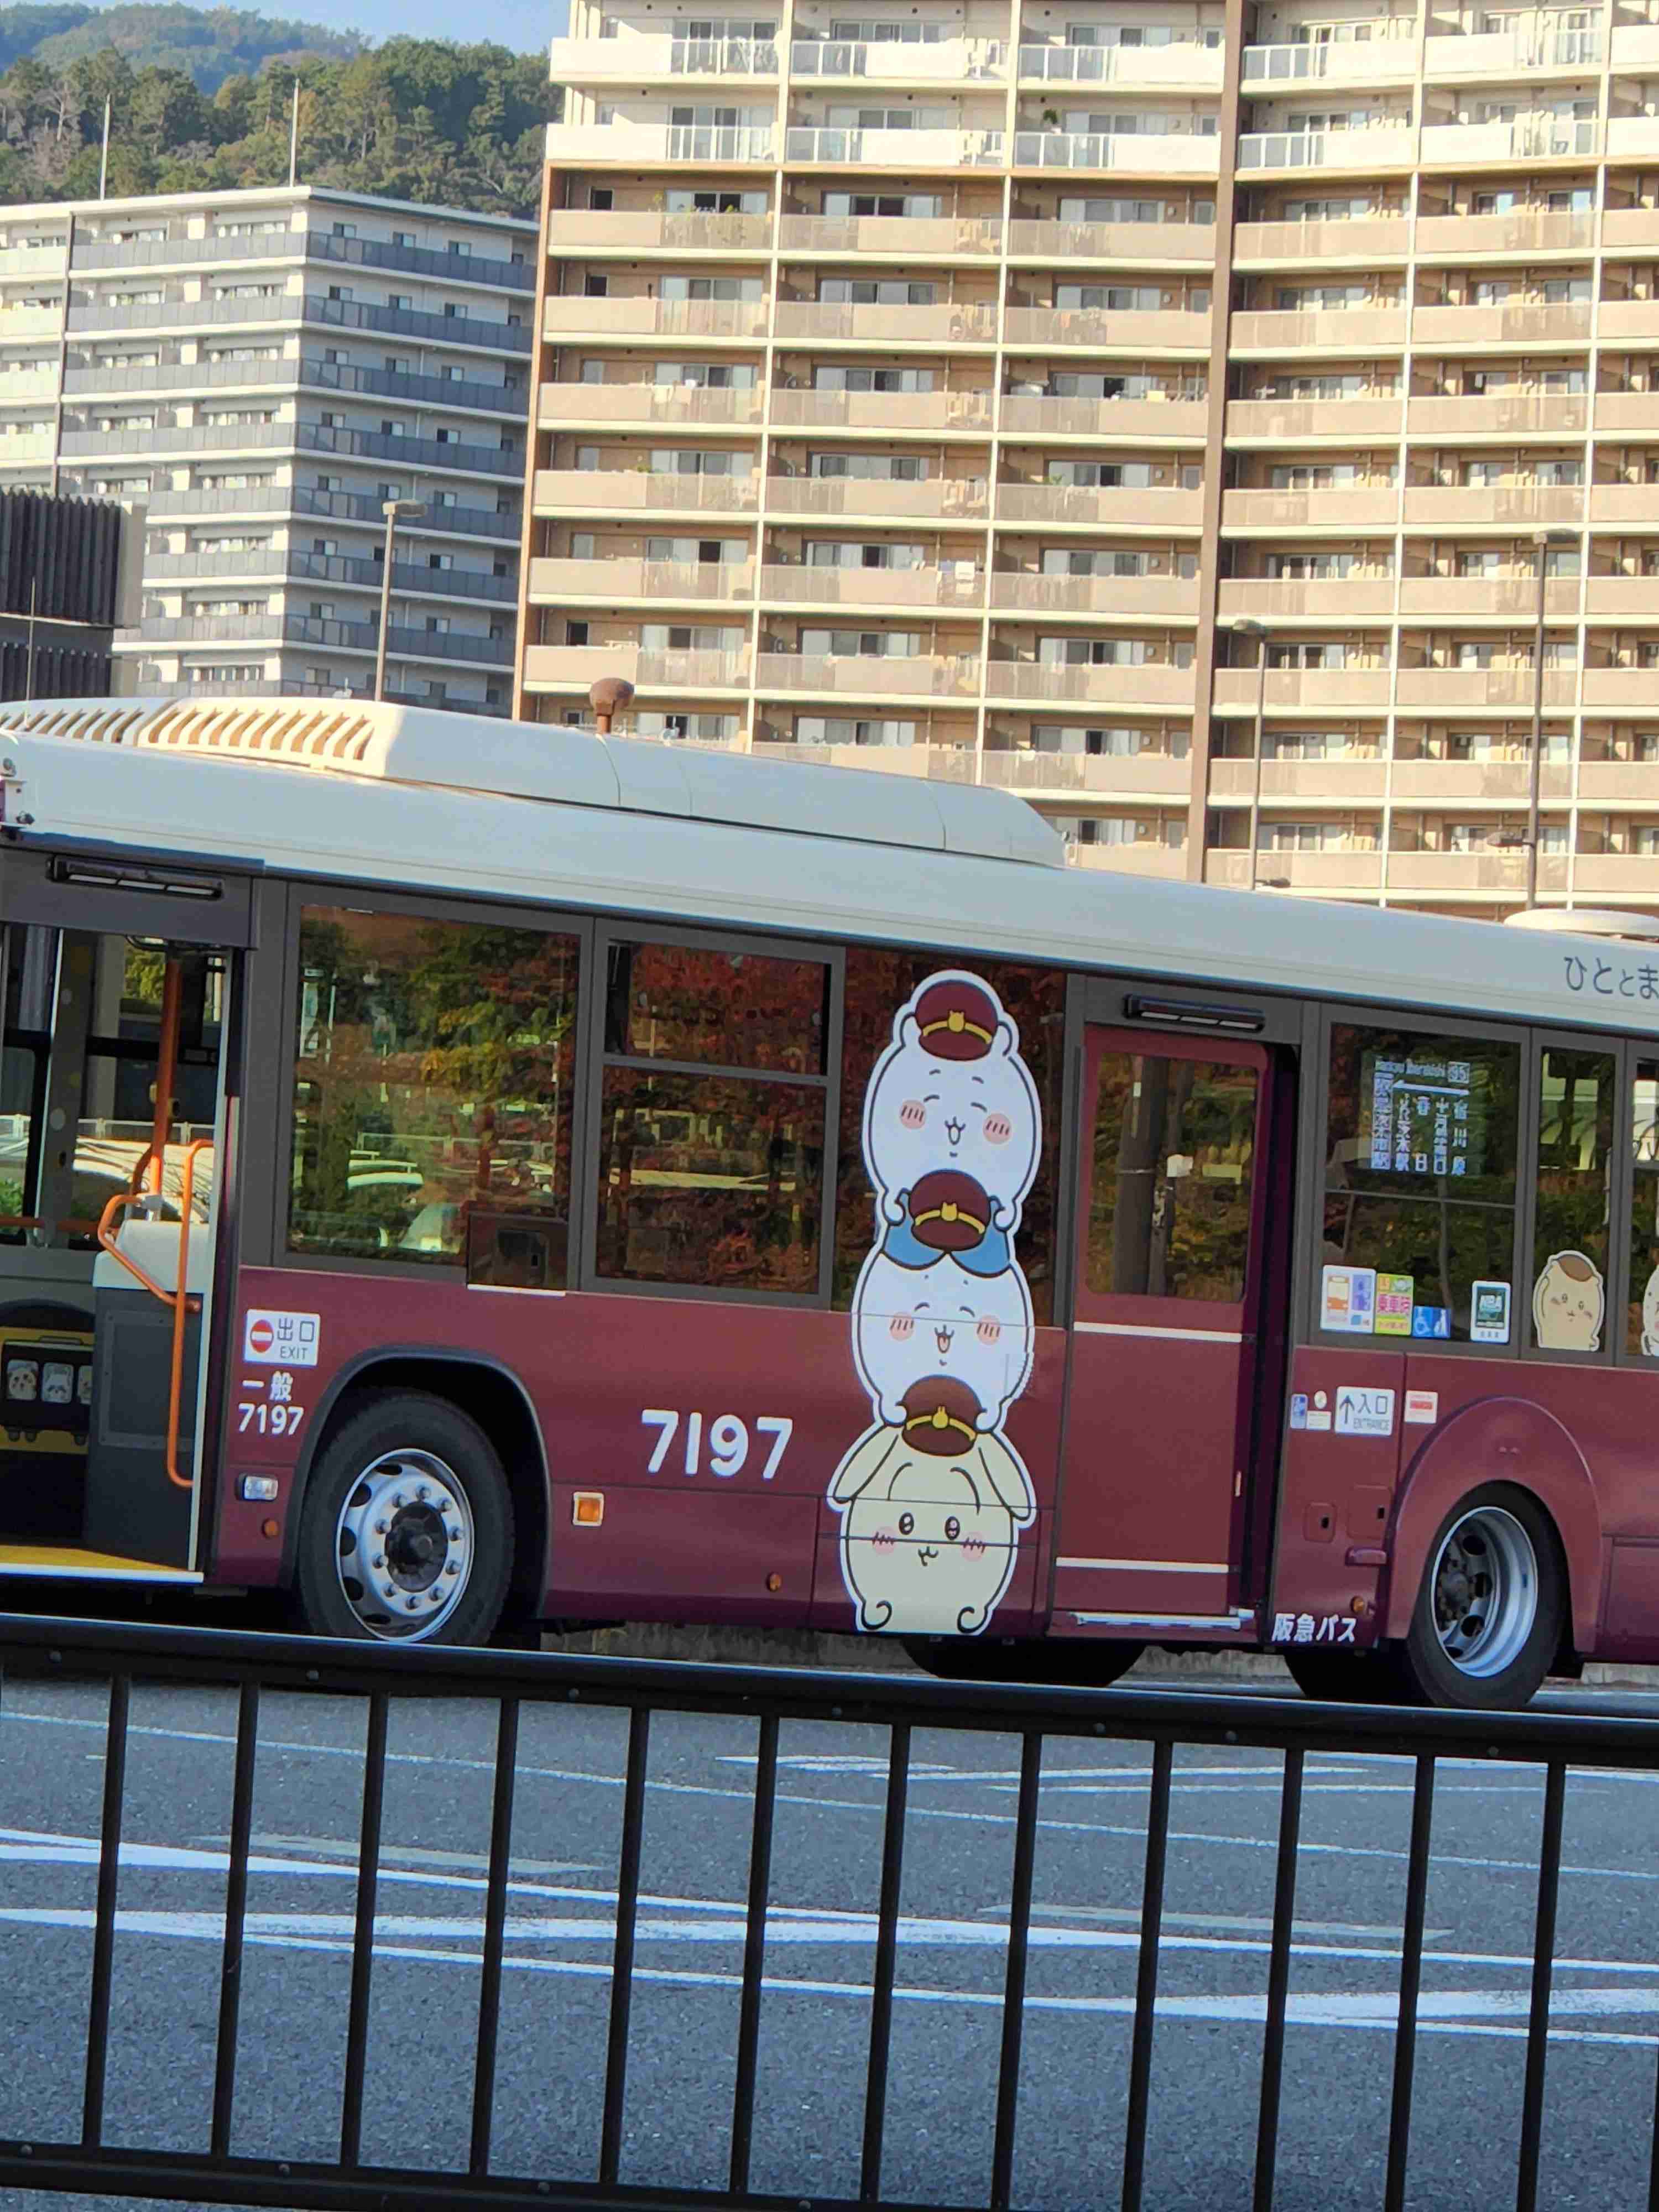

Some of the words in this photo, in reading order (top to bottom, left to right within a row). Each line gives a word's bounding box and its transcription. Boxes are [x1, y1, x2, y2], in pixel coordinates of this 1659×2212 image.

[1564, 956, 1659, 999] ひととま
[277, 1318, 315, 1342] 出口
[280, 1346, 308, 1359] EXIT
[242, 1371, 294, 1402] 一般
[238, 1403, 304, 1435] 7197
[1358, 1393, 1387, 1415] 入口
[641, 1409, 793, 1479] 7197
[1271, 1613, 1357, 1642] 阪急バス
